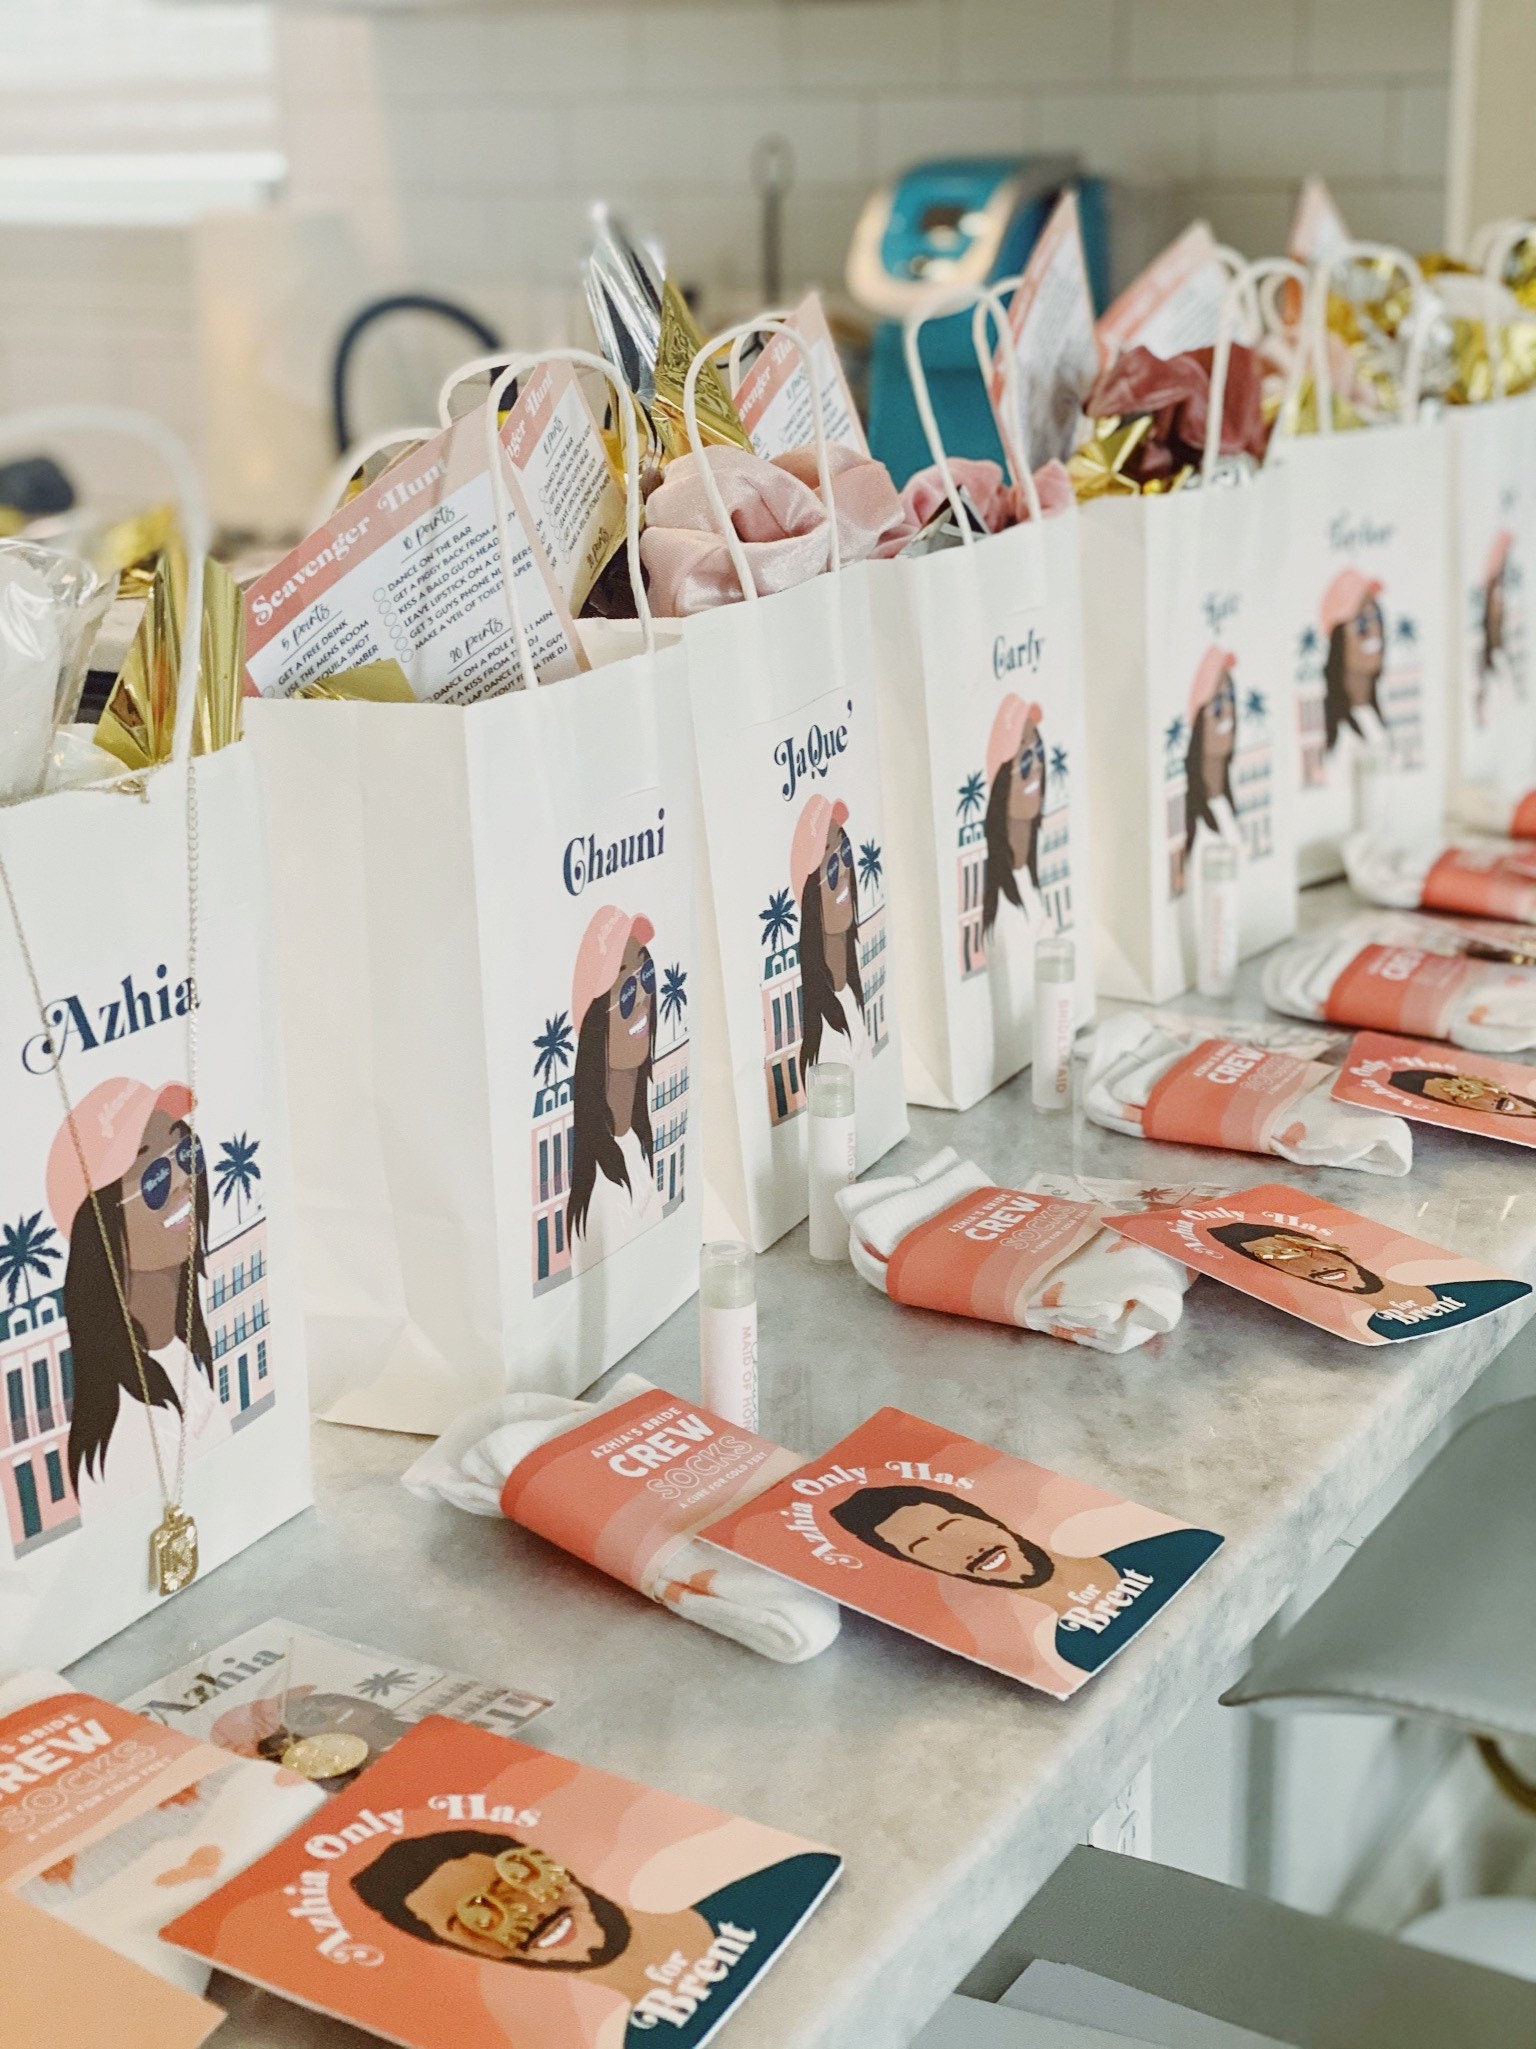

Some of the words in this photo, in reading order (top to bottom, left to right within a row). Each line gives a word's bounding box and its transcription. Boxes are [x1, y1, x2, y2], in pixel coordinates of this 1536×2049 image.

[416, 505, 456, 546] points
[252, 516, 370, 626] Scavenger
[387, 564, 418, 592] DANCE
[419, 553, 435, 568] ON
[435, 537, 451, 556] THE
[453, 525, 472, 545] BAR
[393, 587, 408, 603] GET
[410, 582, 416, 591] A
[417, 563, 441, 586] PIGGY
[442, 547, 465, 567] BACK
[466, 530, 490, 549] FROM
[492, 524, 498, 532] A
[398, 596, 417, 615] KISS
[418, 591, 427, 601] A
[426, 573, 449, 594] BALD
[450, 555, 475, 575] GUYS
[476, 537, 500, 557] HEAD
[403, 602, 430, 627] LEAVE
[431, 575, 467, 606] LIPSTICK
[468, 565, 484, 579] ON
[485, 559, 492, 568] A
[409, 624, 426, 640] GET
[428, 616, 434, 625] 3
[435, 598, 459, 620] GUYS
[460, 576, 490, 599] PHONE
[292, 602, 330, 646] points
[348, 634, 370, 657] SHOT
[415, 631, 438, 650] MAKE
[448, 611, 464, 625] VEIL
[464, 599, 476, 613] OF
[465, 617, 504, 655] points
[278, 665, 294, 685] GET
[296, 662, 303, 670] A
[302, 643, 320, 663] FREE
[321, 619, 348, 647] DRINK
[284, 681, 300, 698] USE
[300, 666, 316, 683] THE
[316, 644, 339, 668] MENS
[340, 620, 370, 646] ROOM
[433, 676, 463, 701] DANCE
[464, 662, 480, 678] ON
[481, 657, 489, 667] A
[488, 643, 510, 661] POLE
[535, 610, 553, 628] MIN
[457, 691, 465, 700] A
[465, 676, 483, 693] KISS
[483, 656, 511, 677] FROM
[528, 636, 539, 647] DJ
[468, 689, 482, 704] LAP
[484, 670, 511, 691] DANCE
[539, 646, 546, 654] A
[547, 632, 564, 648] GUY
[542, 651, 557, 666] THE
[556, 643, 568, 655] DJ
[993, 628, 1045, 681] Carly
[563, 807, 666, 896] Chauni
[22, 964, 202, 1075] Azhia
[1207, 1047, 1266, 1084] CREW
[965, 1196, 1042, 1241] CREW
[1000, 1204, 1077, 1250] SOCKS
[1181, 1207, 1245, 1221] Only
[1262, 1211, 1334, 1237] Has
[1375, 1295, 1466, 1325] Brent
[1388, 1300, 1418, 1310] for
[743, 1326, 751, 1366] MAID
[743, 1371, 752, 1389] OF
[591, 1428, 643, 1459] AZHIA'S
[642, 1407, 682, 1431] BRIDE
[608, 1413, 715, 1477] CREW
[647, 1435, 752, 1499] SOCKS
[680, 1501, 687, 1509] A
[710, 1477, 726, 1491] FOR
[792, 1463, 869, 1497] Only
[885, 1460, 976, 1491] Has
[781, 1501, 863, 1570] Azhia
[1058, 1568, 1154, 1634] Brent
[1067, 1583, 1102, 1608] for
[0, 1719, 112, 1793] REW
[305, 1803, 406, 1861] Only
[427, 1793, 542, 1828] Has
[283, 1870, 385, 1967] Azhia
[630, 1920, 758, 2032] Brent
[644, 1949, 684, 1986] for
